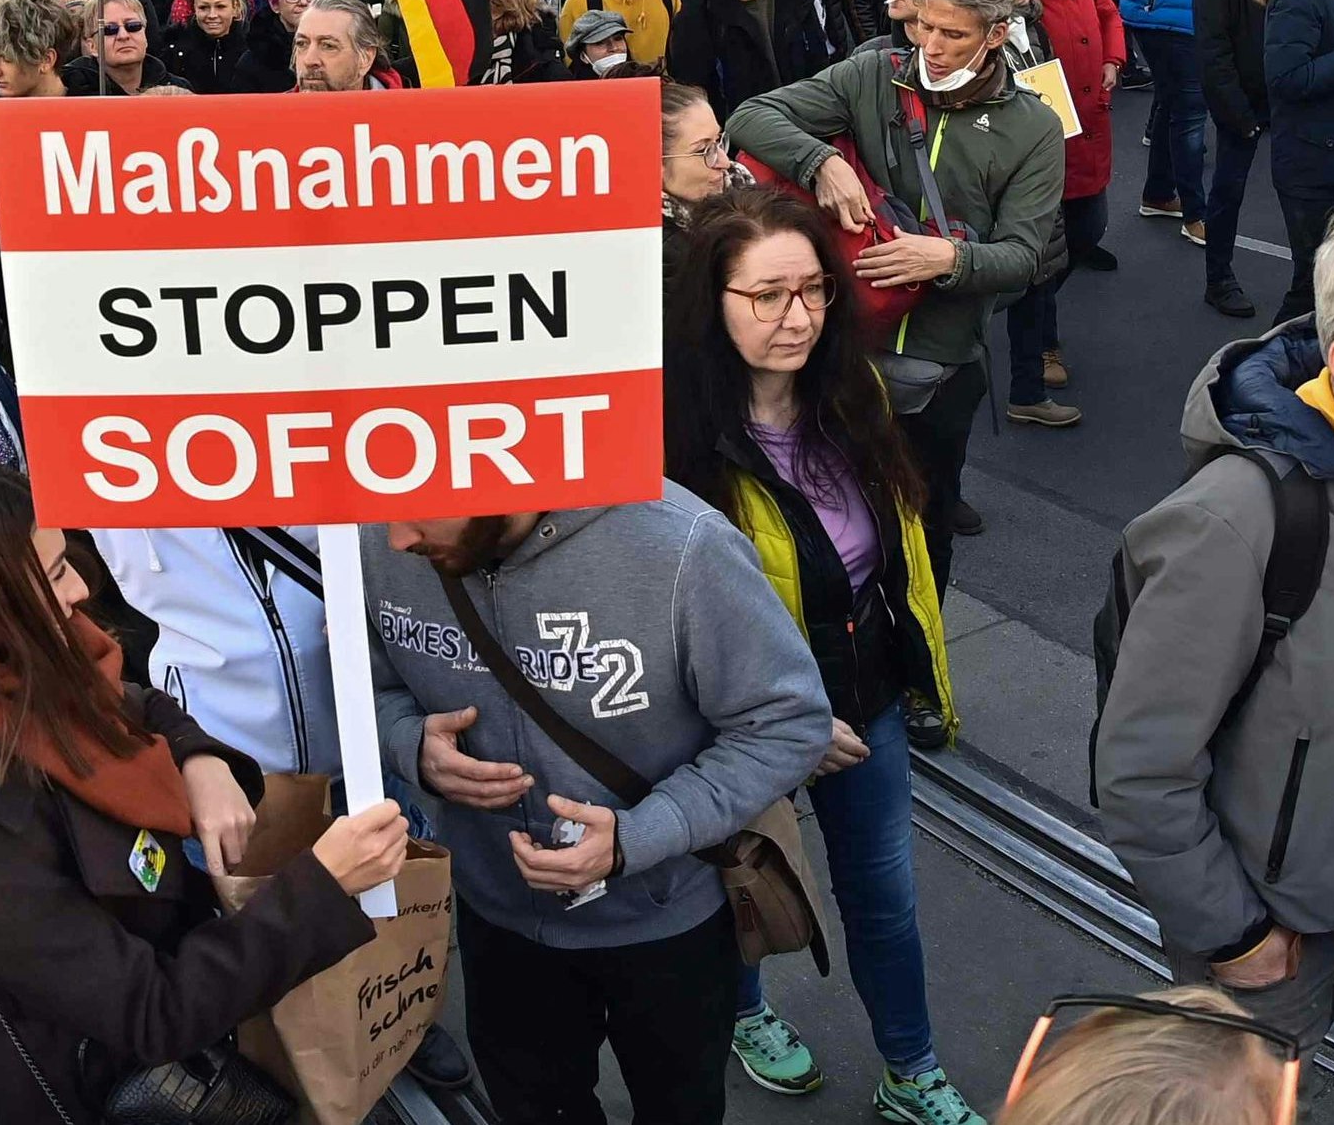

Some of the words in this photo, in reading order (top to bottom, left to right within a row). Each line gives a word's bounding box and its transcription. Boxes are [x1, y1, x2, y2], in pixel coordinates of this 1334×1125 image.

[40, 123, 611, 216] Maßnahmen
[98, 270, 569, 358] STOPPEN
[81, 394, 611, 503] SOFORT
[379, 611, 461, 660] BIKES
[387, 900, 443, 922] urkerl
[358, 947, 434, 1020] frisch
